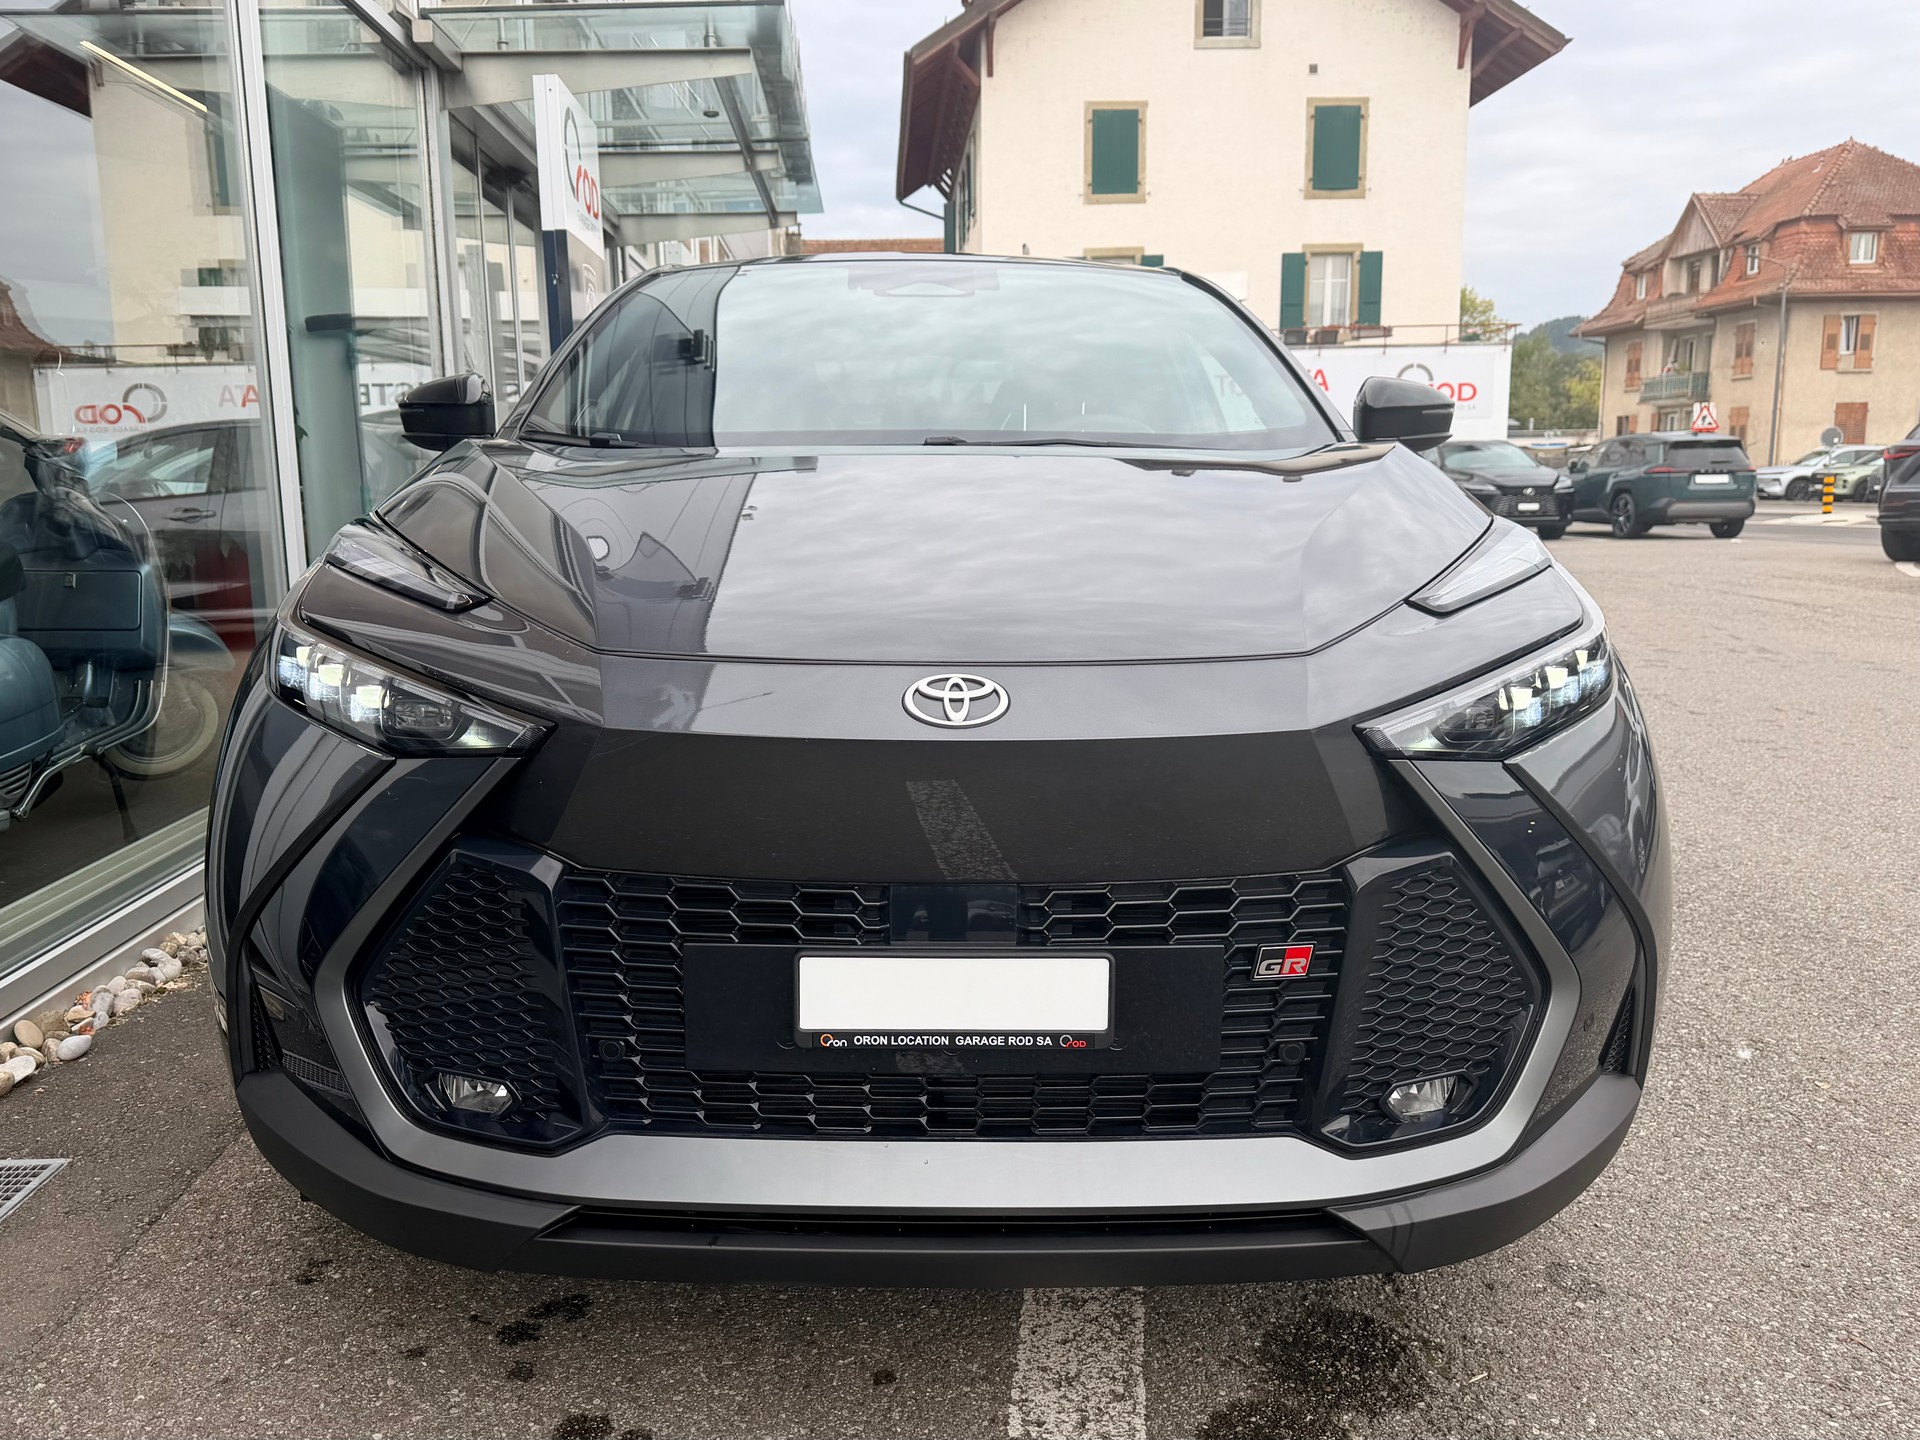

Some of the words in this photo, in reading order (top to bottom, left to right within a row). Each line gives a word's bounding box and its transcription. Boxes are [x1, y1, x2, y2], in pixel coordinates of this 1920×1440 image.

[1258, 958, 1307, 975] GR
[853, 1035, 888, 1046] ORON
[890, 1035, 949, 1046] LOCATION
[955, 1035, 1006, 1046] GARAGE
[1008, 1036, 1034, 1046] ROD
[1036, 1036, 1053, 1046] SA
